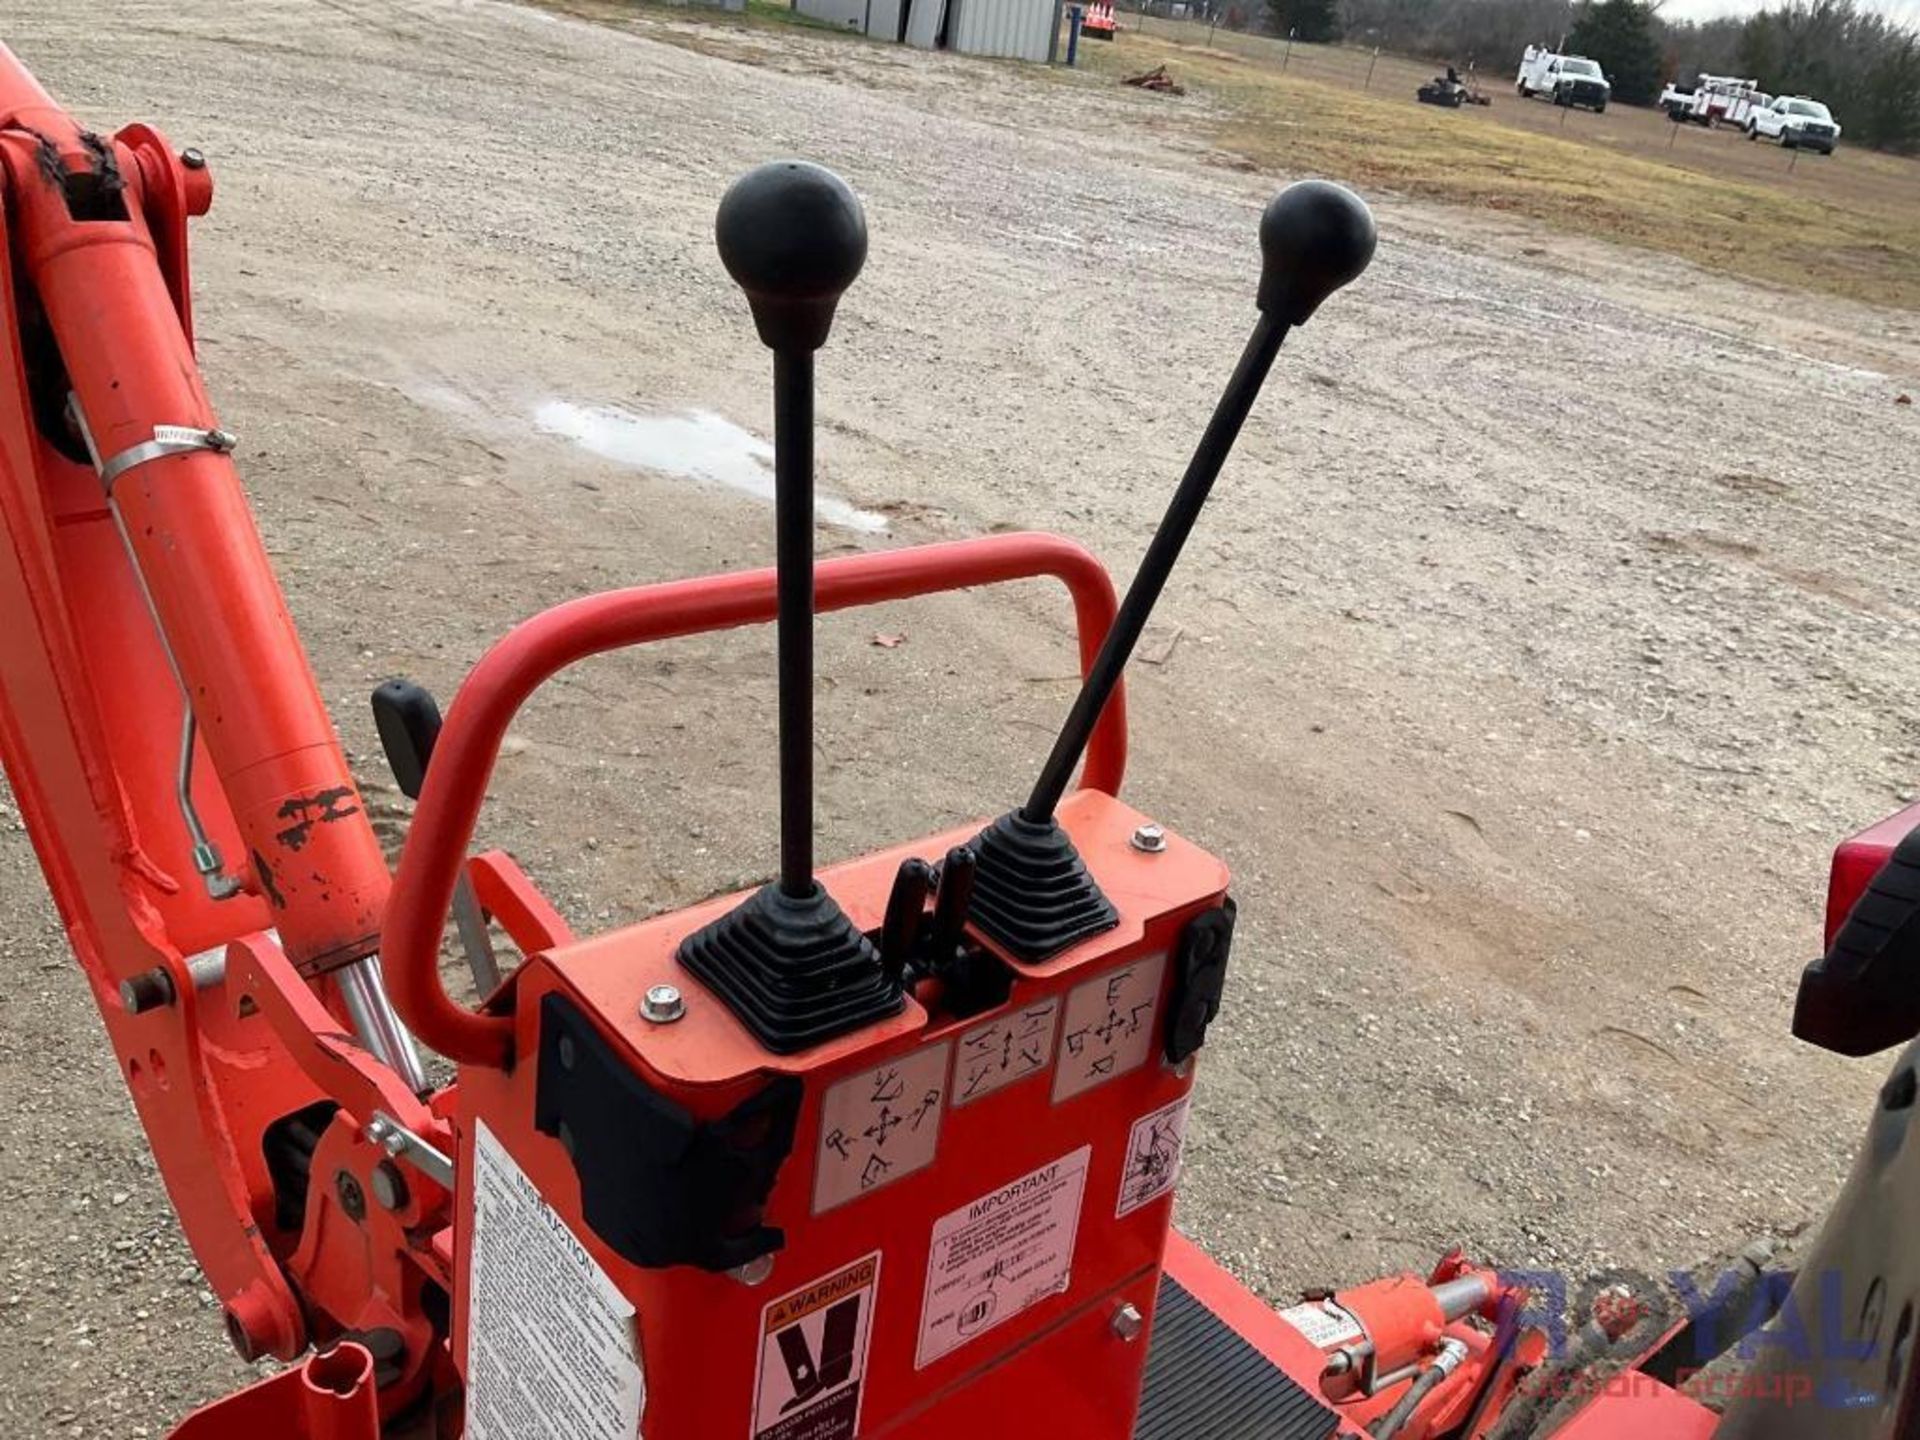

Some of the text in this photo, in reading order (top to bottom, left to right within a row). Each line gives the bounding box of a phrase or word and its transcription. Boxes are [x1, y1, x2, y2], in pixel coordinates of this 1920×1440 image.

[969, 1164, 1060, 1221] IMPORTANT
[515, 1171, 595, 1278] INSTRUCTION
[789, 1264, 872, 1314] WARNING
